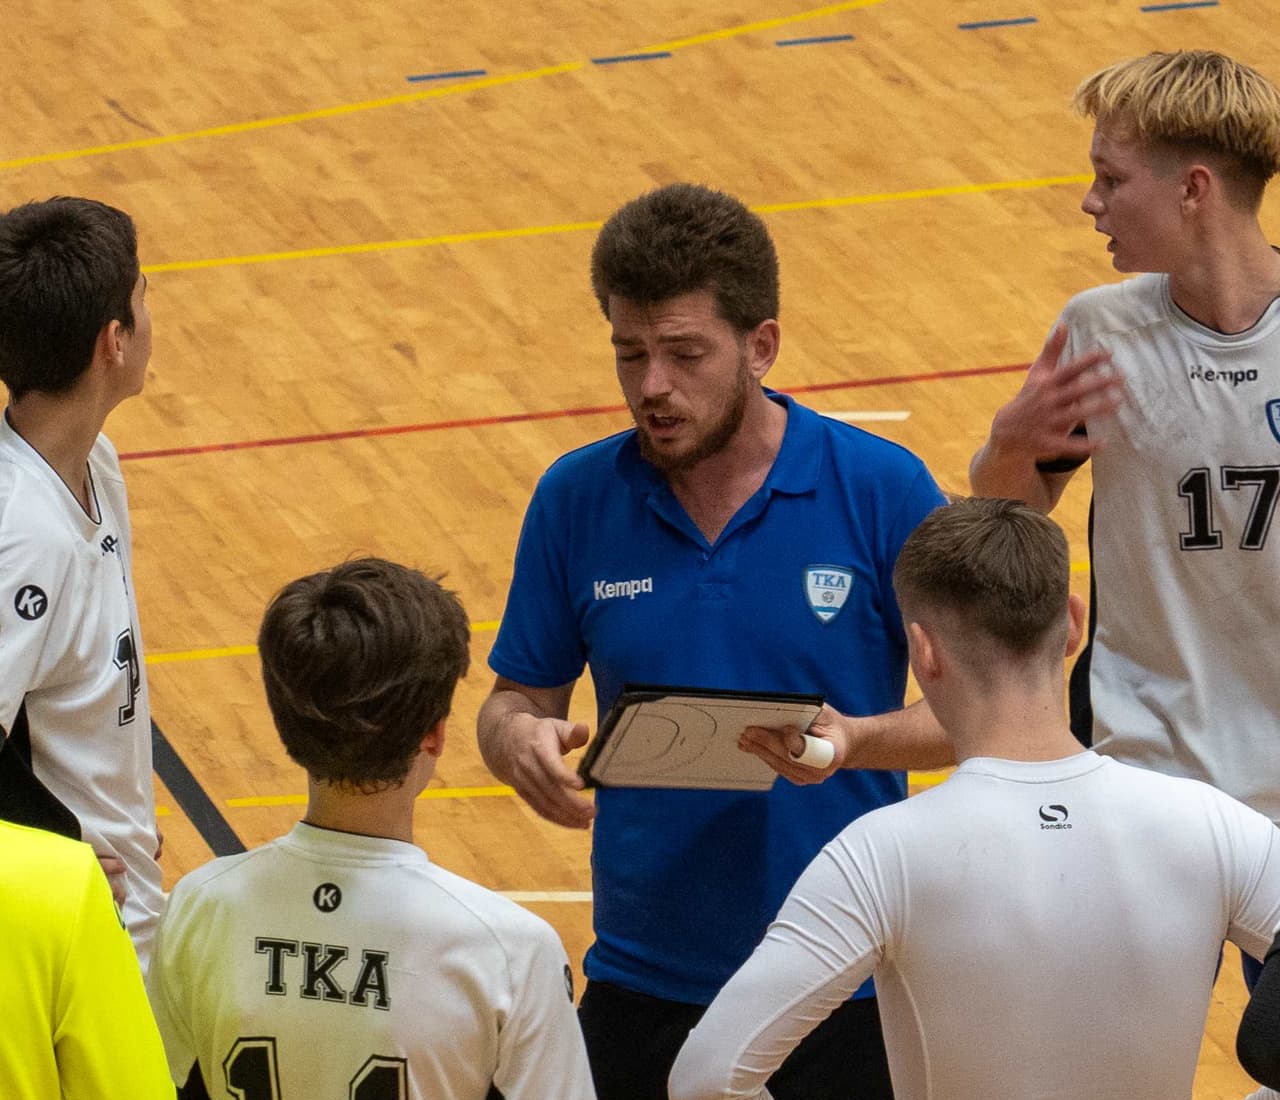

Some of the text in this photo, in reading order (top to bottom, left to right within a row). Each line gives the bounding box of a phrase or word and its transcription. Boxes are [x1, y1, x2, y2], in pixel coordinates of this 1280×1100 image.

[593, 577, 653, 601] Kempa
[812, 572, 847, 588] TKA
[255, 936, 391, 1011] TKA
